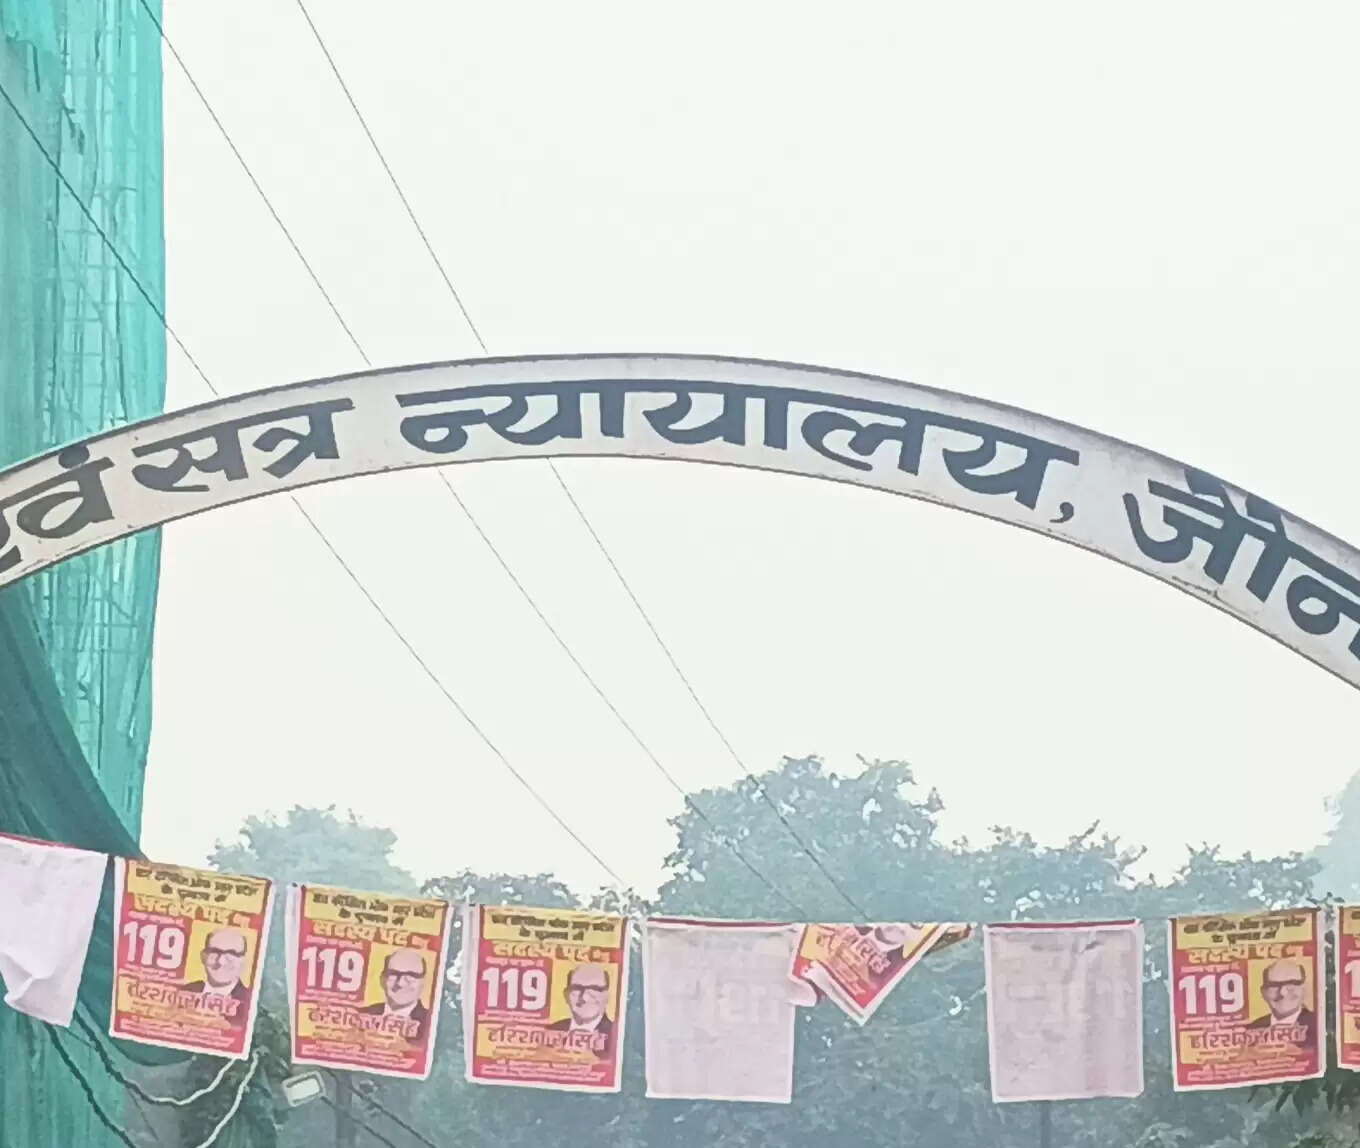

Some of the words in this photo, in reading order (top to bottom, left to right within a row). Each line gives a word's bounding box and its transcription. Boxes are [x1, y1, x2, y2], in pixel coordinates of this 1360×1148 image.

[131, 398, 354, 495] सत्र
[395, 379, 1080, 524] न्यायालय,
[123, 921, 186, 970] 119
[301, 945, 365, 992] 119
[482, 967, 548, 1012] 119
[1178, 972, 1245, 1015] 119
